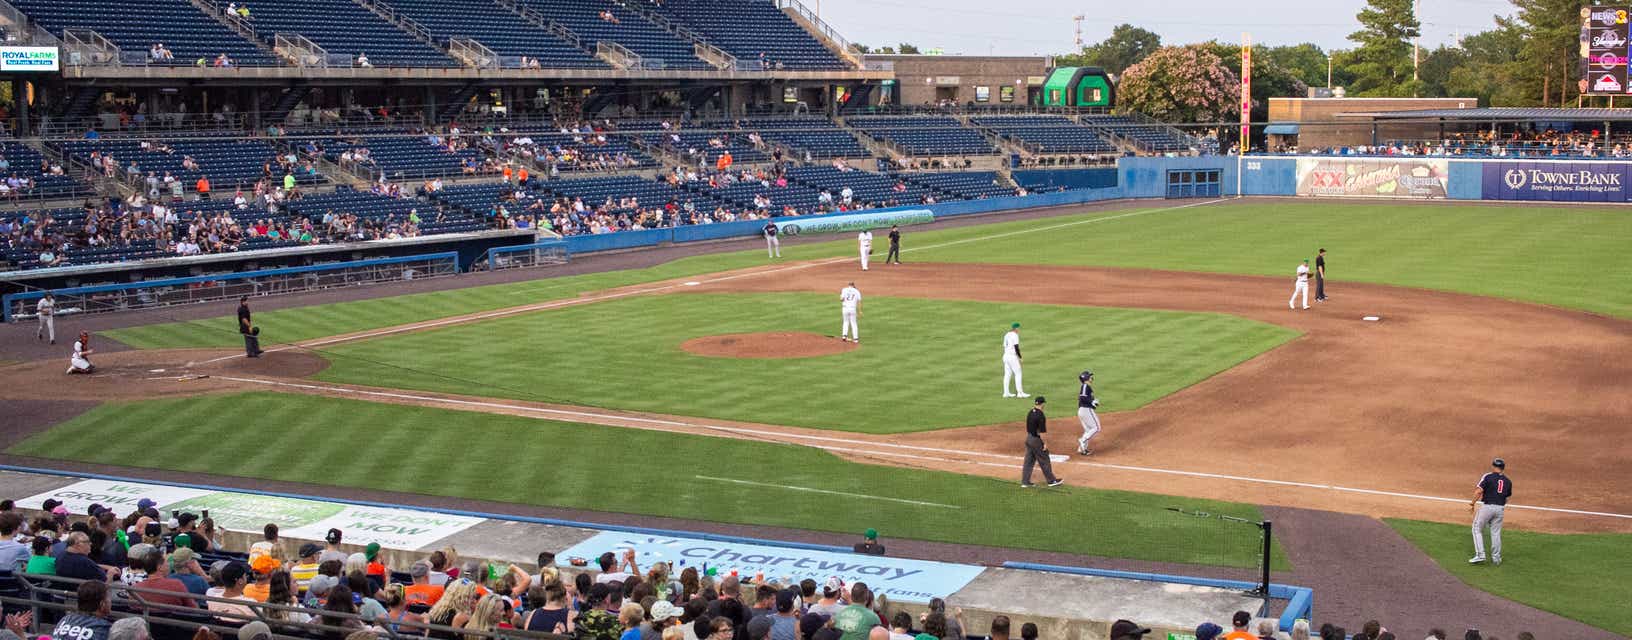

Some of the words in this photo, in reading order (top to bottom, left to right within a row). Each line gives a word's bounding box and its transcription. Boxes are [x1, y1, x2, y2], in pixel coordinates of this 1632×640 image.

[1313, 171, 1344, 187] XX
[107, 484, 153, 494] WE
[1497, 480, 1504, 493] 1
[346, 522, 431, 535] MOW
[680, 547, 923, 580] Chartway
